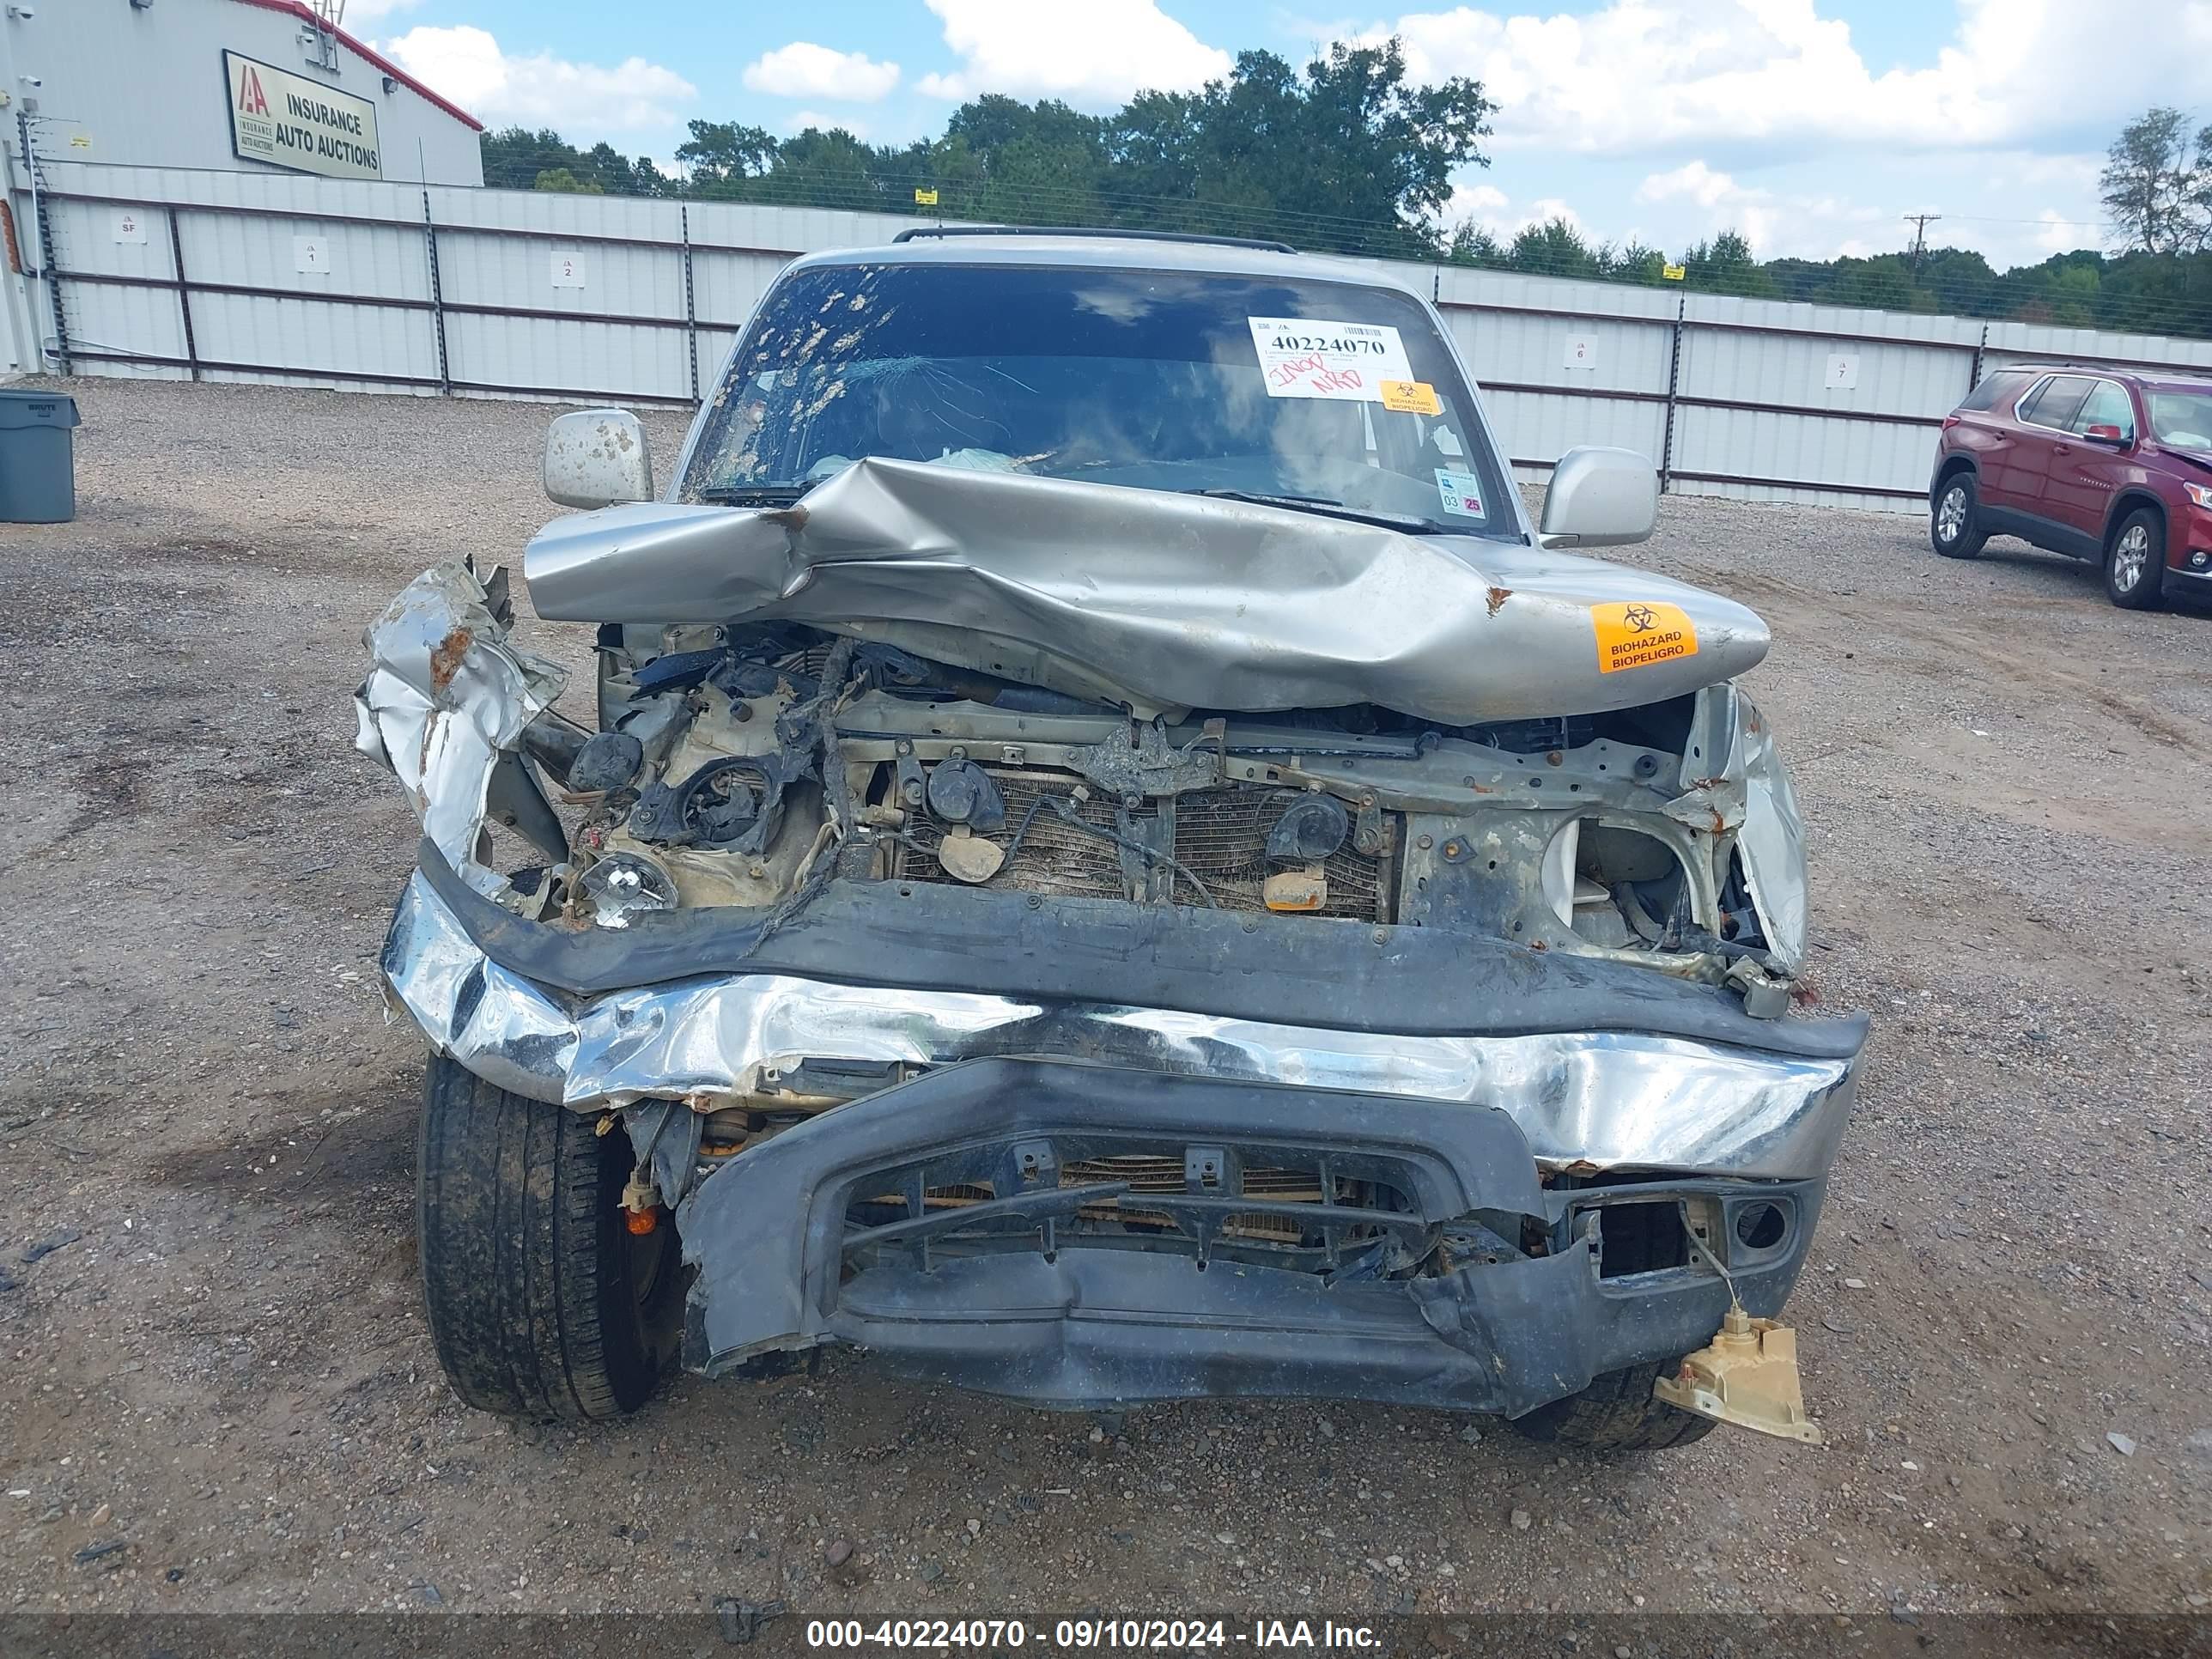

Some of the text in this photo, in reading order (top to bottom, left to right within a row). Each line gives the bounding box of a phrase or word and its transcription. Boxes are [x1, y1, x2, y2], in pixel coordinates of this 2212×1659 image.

[286, 93, 362, 137] INSURANCE
[240, 120, 273, 137] INSURANCE
[241, 136, 274, 152] AUTO AUCTIONS
[276, 123, 378, 170] AUTO AUCTIONS
[122, 223, 136, 232] SF
[309, 253, 314, 262] 1
[565, 268, 571, 276] 2
[1272, 336, 1385, 356] 40224070
[1392, 404, 1433, 413] BIOPELIGRO
[1444, 495, 1480, 511] 03 25
[1611, 631, 1682, 655] BIOHAZARD
[1612, 645, 1685, 668] BIOPELIGRO
